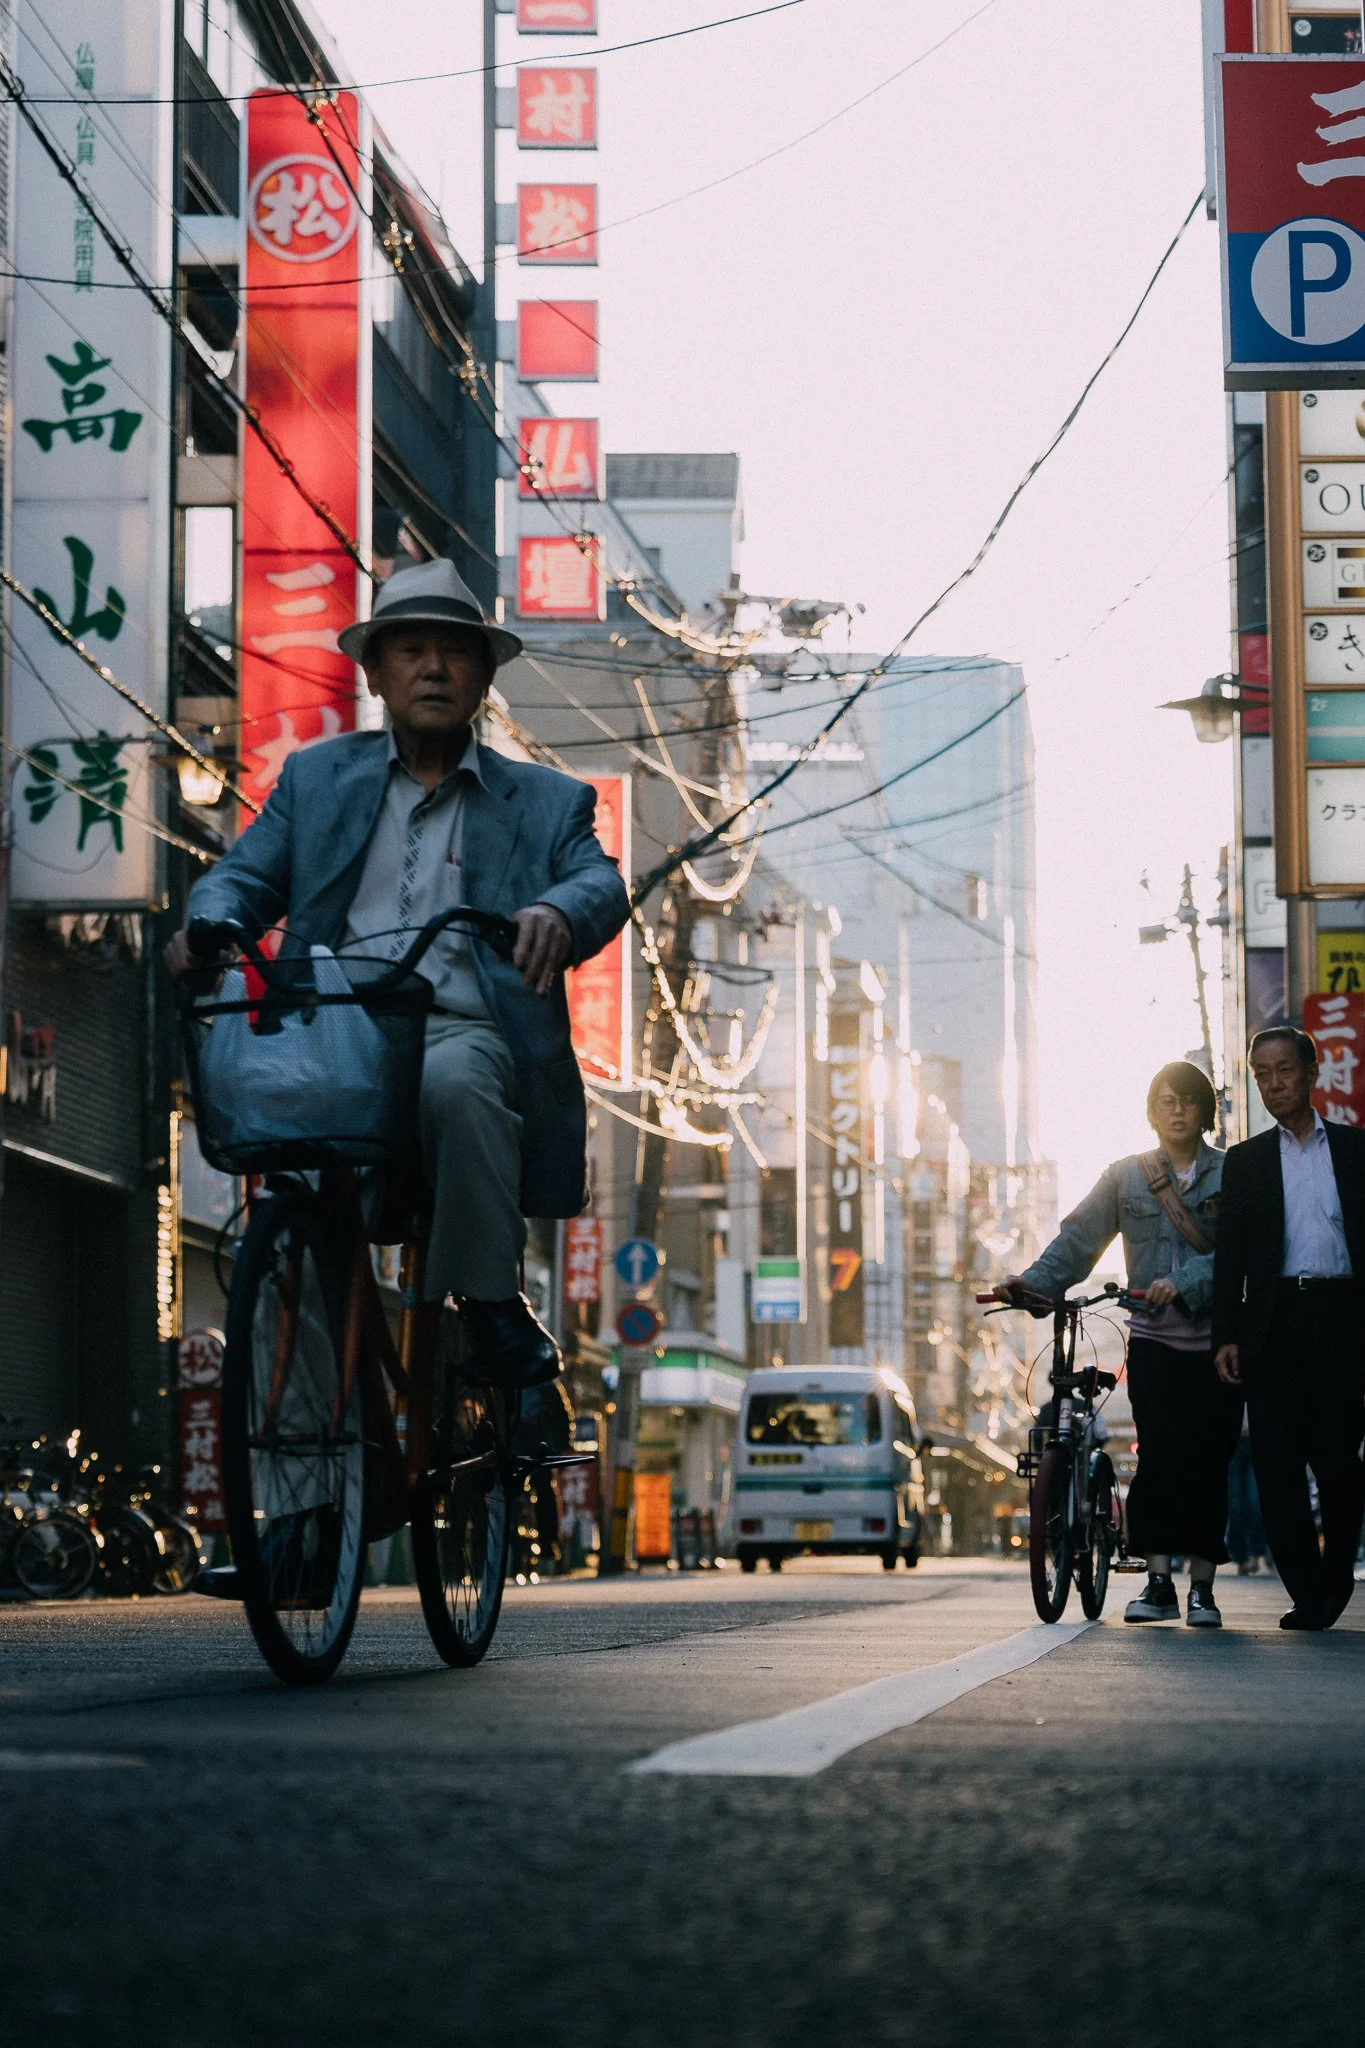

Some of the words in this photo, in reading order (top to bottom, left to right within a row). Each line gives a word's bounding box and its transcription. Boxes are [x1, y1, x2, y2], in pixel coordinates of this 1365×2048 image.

[259, 172, 347, 246] 松
[1288, 230, 1352, 337] P
[1319, 483, 1365, 516] O
[1341, 563, 1365, 583] G
[1322, 804, 1365, 820] クラ
[831, 1249, 861, 1291] 7
